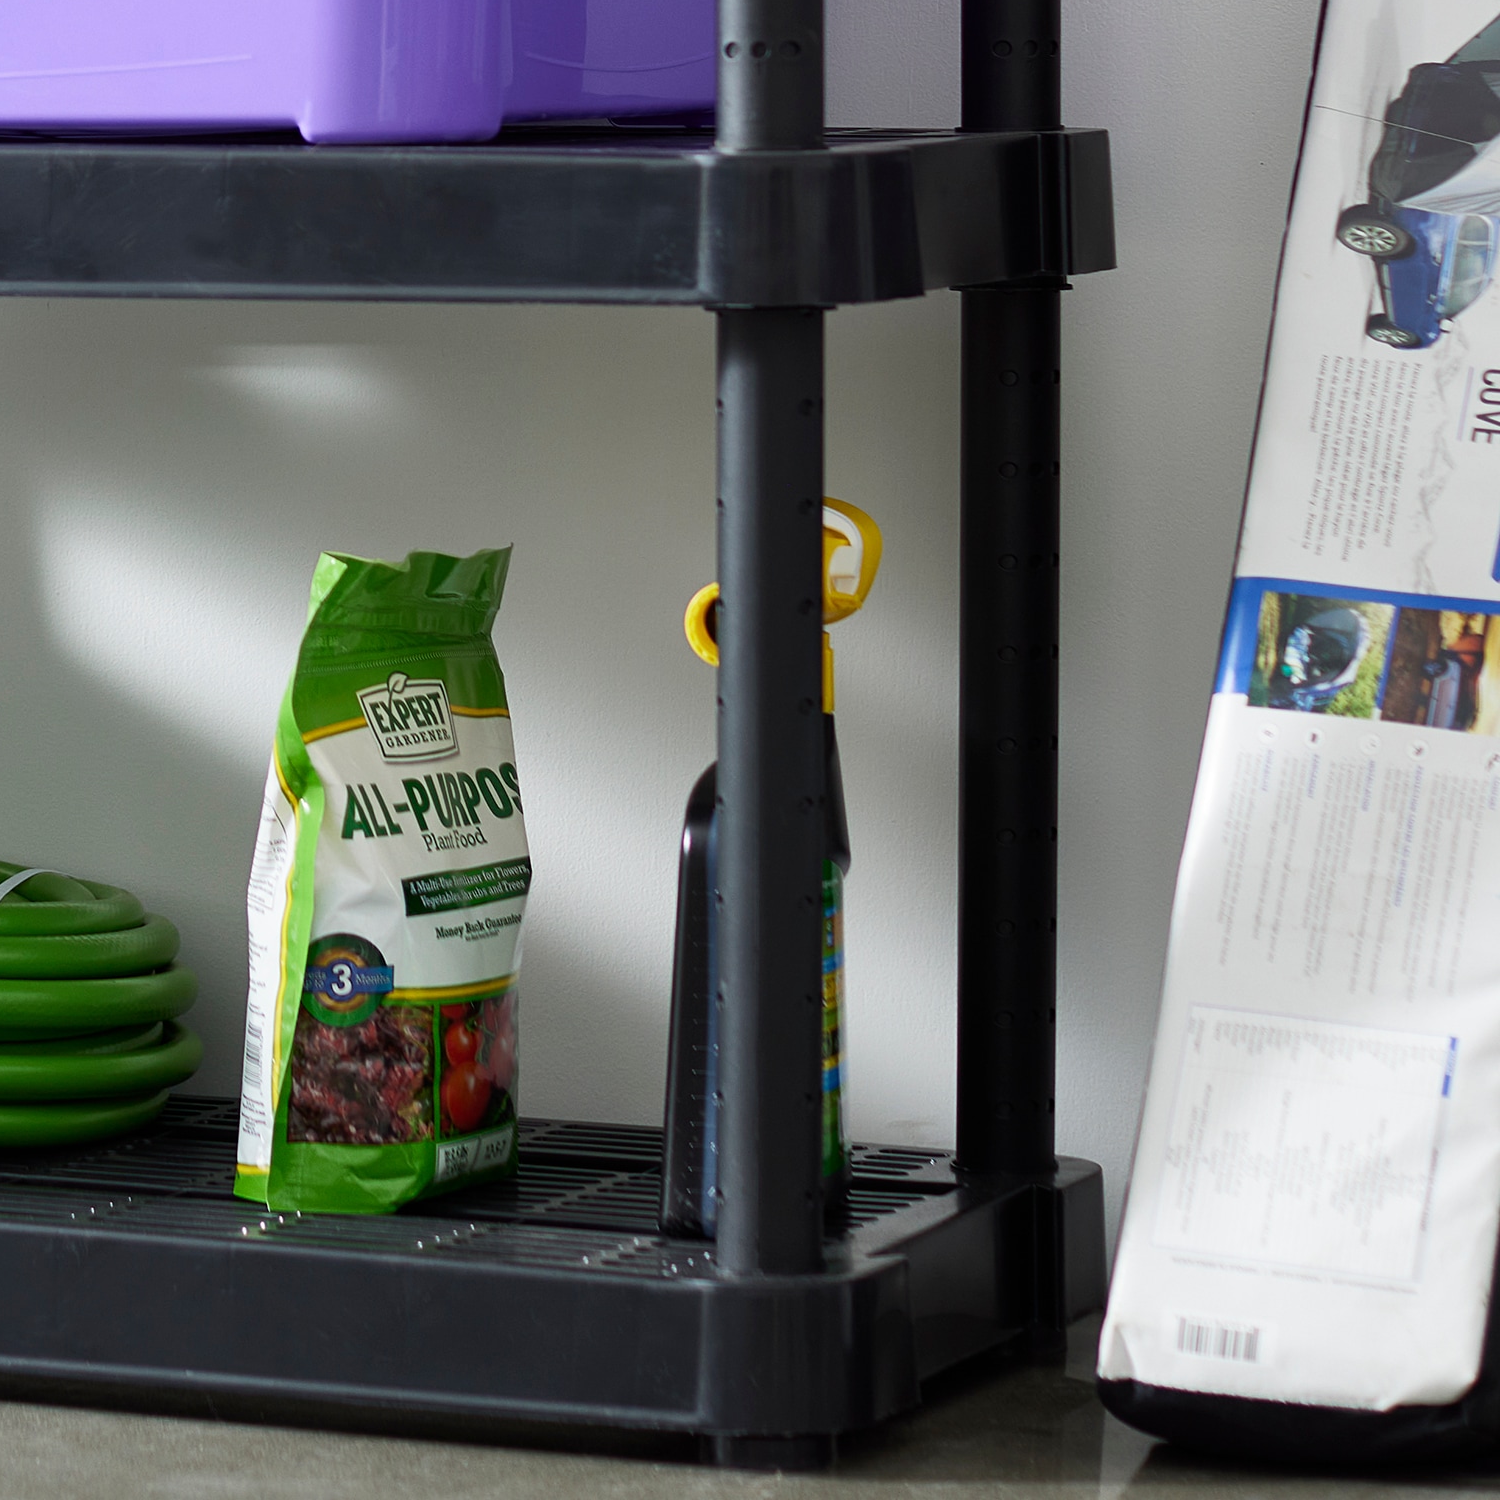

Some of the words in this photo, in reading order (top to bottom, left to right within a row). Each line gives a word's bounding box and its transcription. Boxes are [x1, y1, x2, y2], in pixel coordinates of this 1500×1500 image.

[369, 692, 446, 734] EXPERT
[386, 729, 450, 749] GARDENER
[454, 827, 488, 851] Food
[503, 879, 526, 892] Trees
[435, 925, 464, 940] Money
[464, 918, 485, 934] Back
[331, 963, 353, 997] 3
